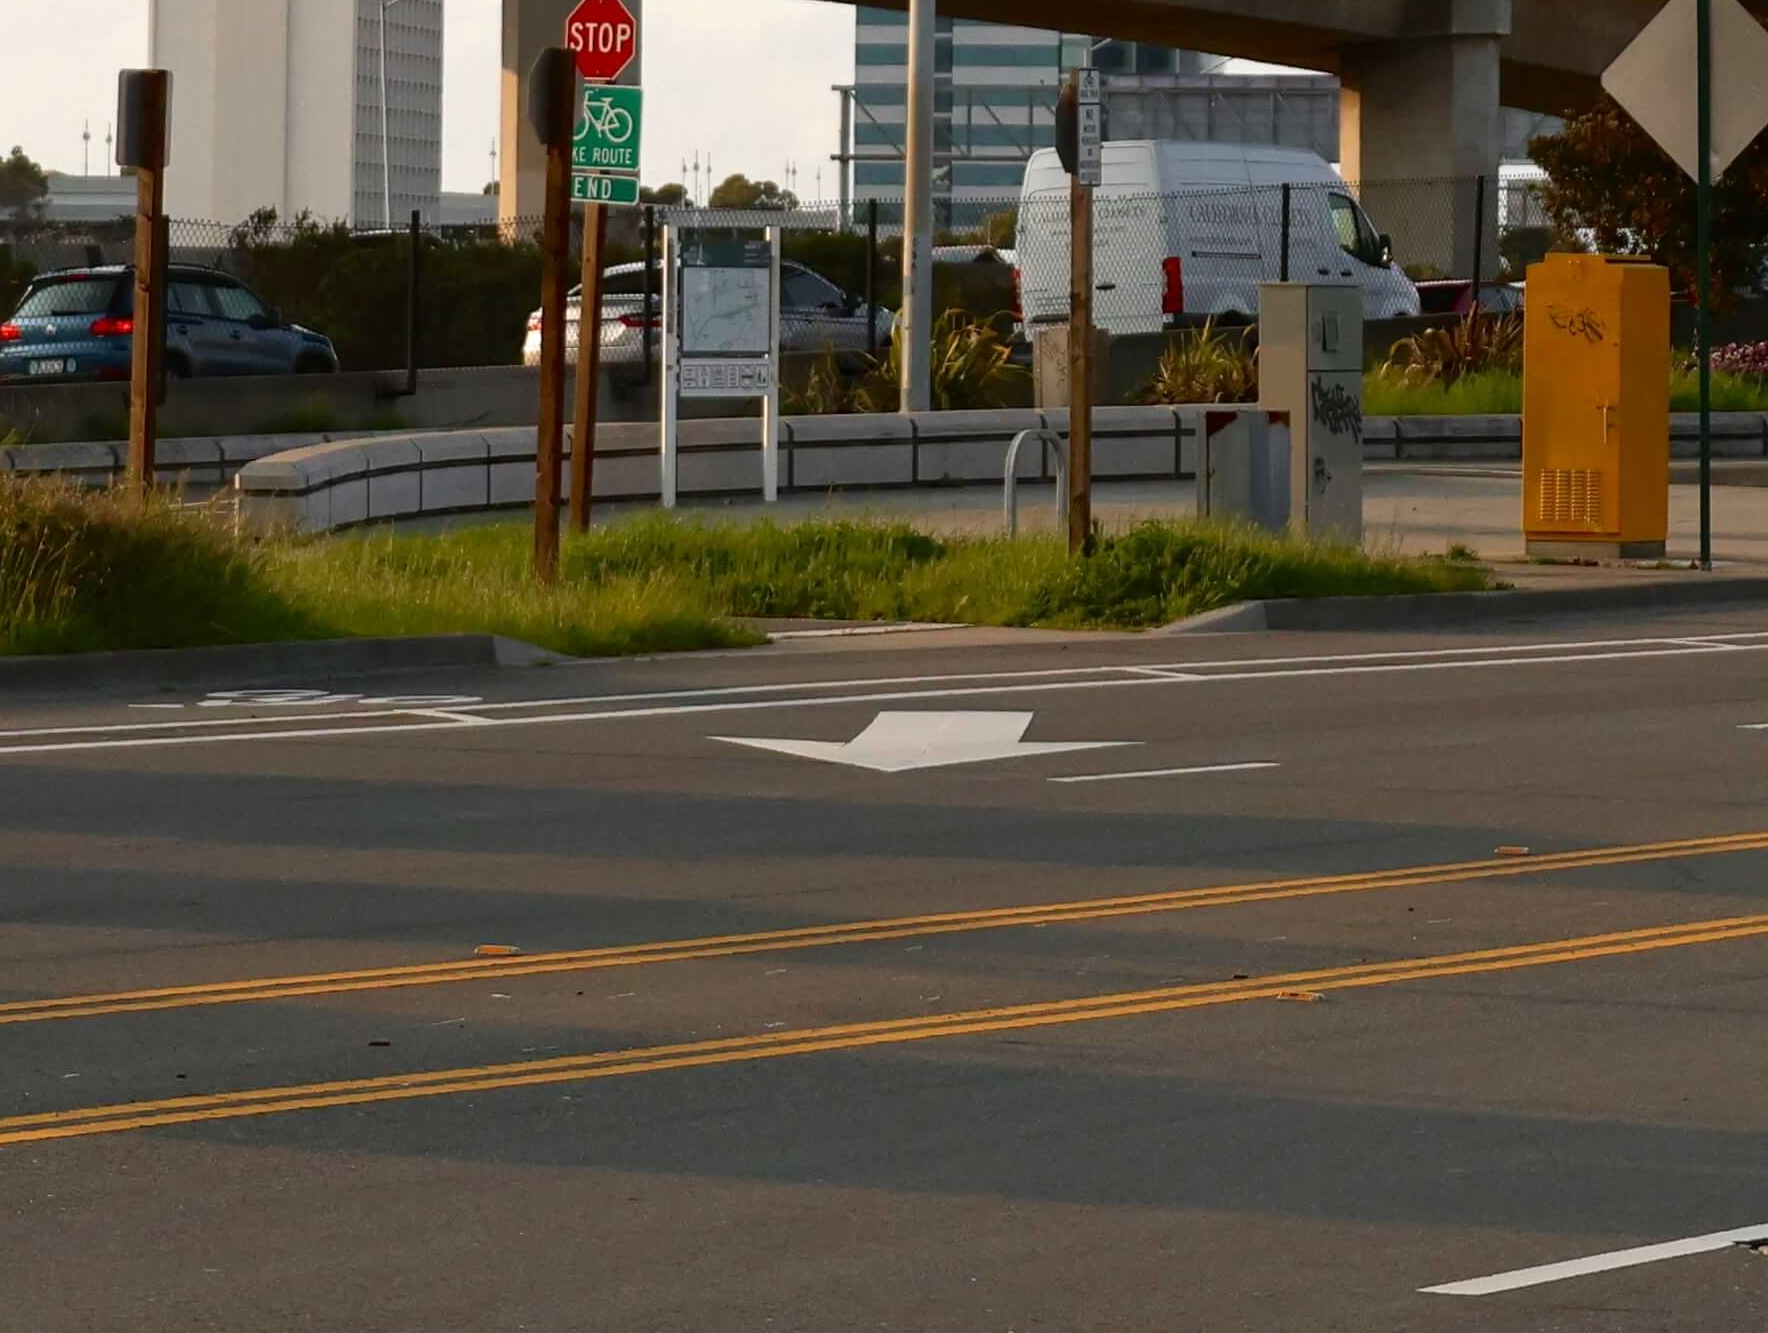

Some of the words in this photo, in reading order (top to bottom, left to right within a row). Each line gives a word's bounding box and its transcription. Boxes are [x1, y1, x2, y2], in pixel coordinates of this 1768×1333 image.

[570, 22, 631, 53] STOP
[593, 148, 632, 164] ROUTE
[574, 177, 612, 199] END
